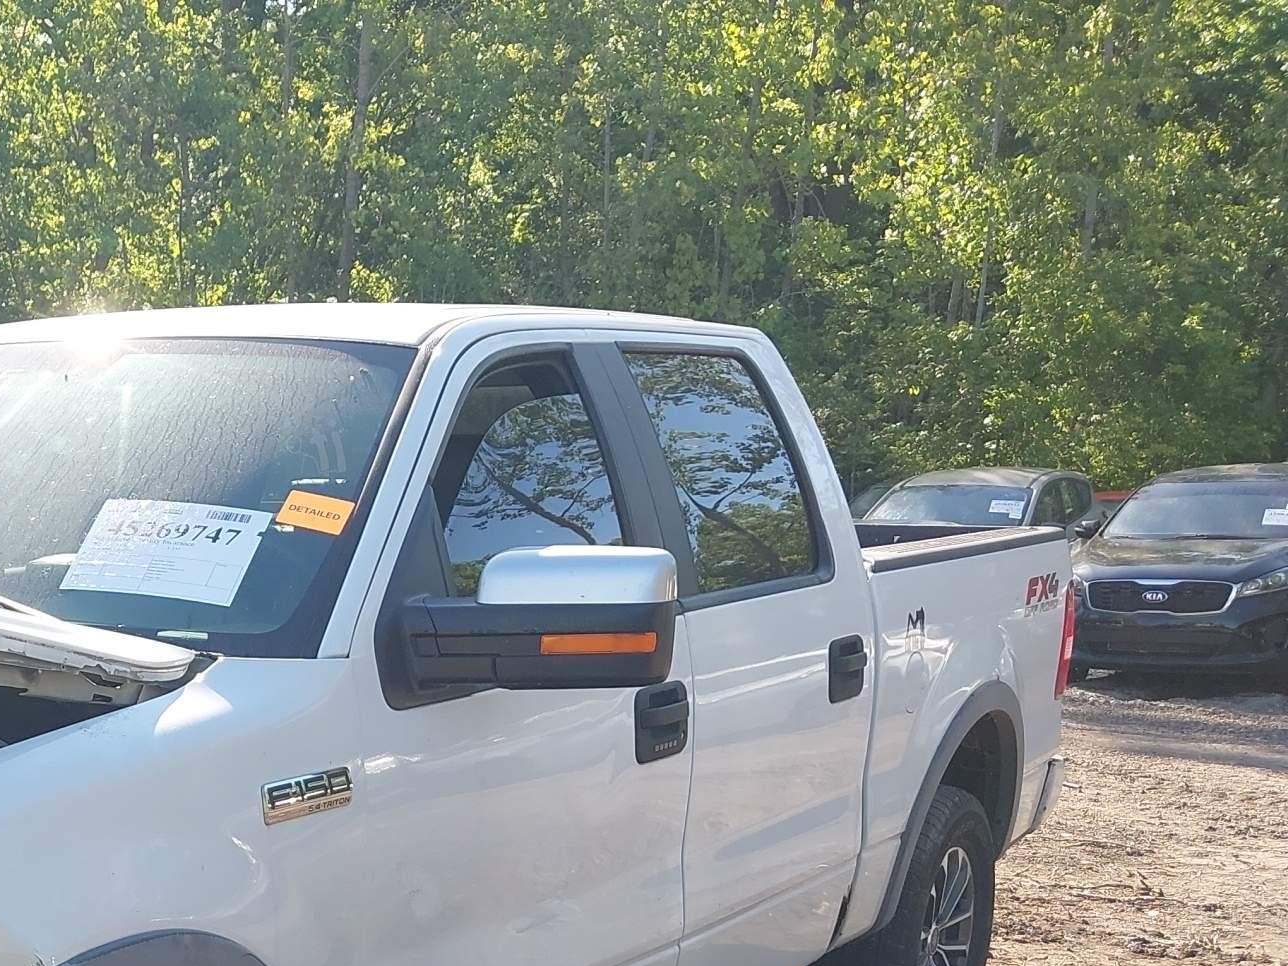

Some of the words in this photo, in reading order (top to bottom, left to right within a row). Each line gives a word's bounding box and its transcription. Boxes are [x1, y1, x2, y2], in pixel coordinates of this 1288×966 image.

[289, 504, 341, 521] DETAILED
[107, 519, 242, 547] 45269747
[1025, 572, 1059, 606] FX4
